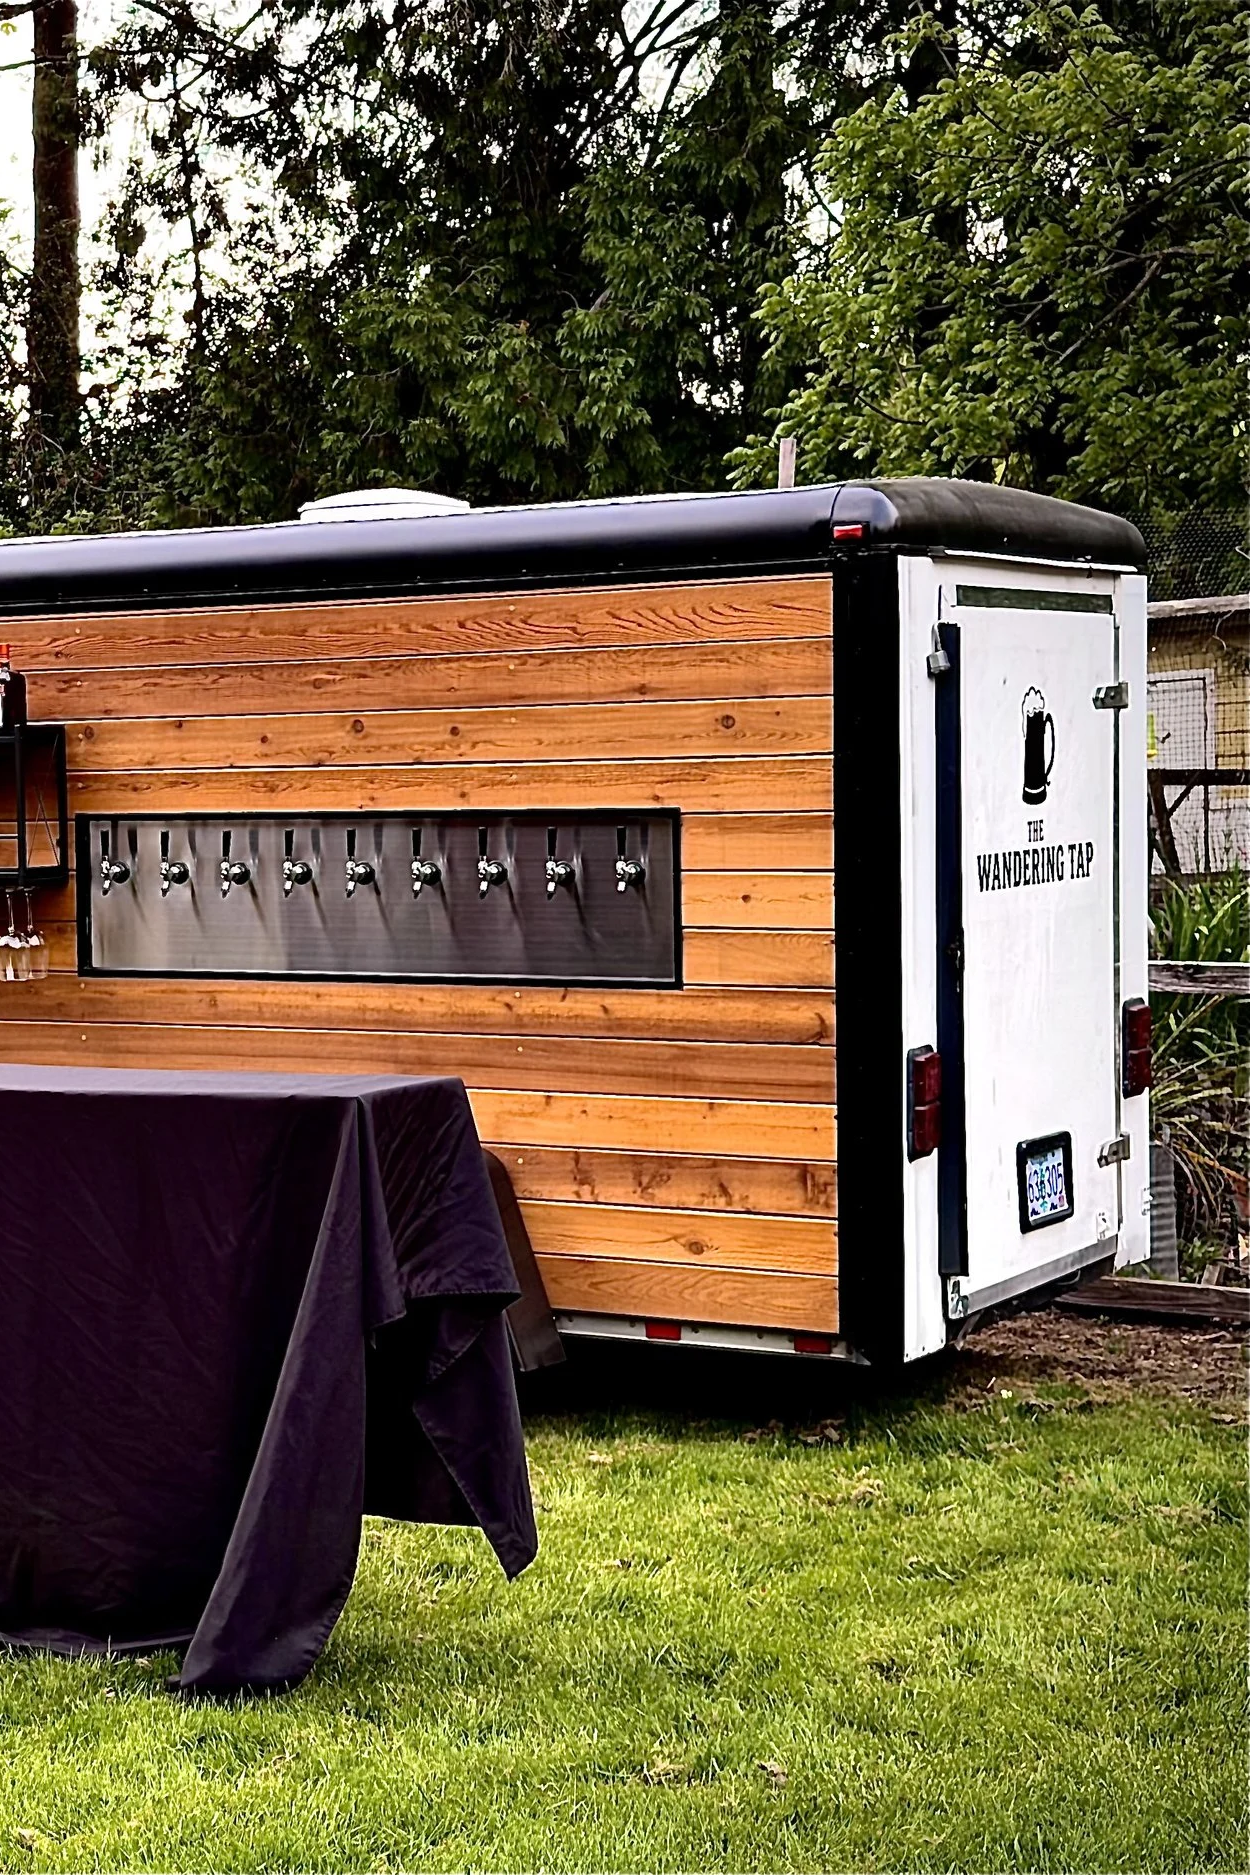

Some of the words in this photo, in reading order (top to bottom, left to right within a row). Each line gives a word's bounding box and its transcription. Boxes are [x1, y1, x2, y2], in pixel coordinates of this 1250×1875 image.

[1027, 819, 1044, 842] THE
[977, 844, 1064, 892] WANDERING
[1068, 841, 1094, 880] TAP
[1028, 1162, 1064, 1203] 636305
